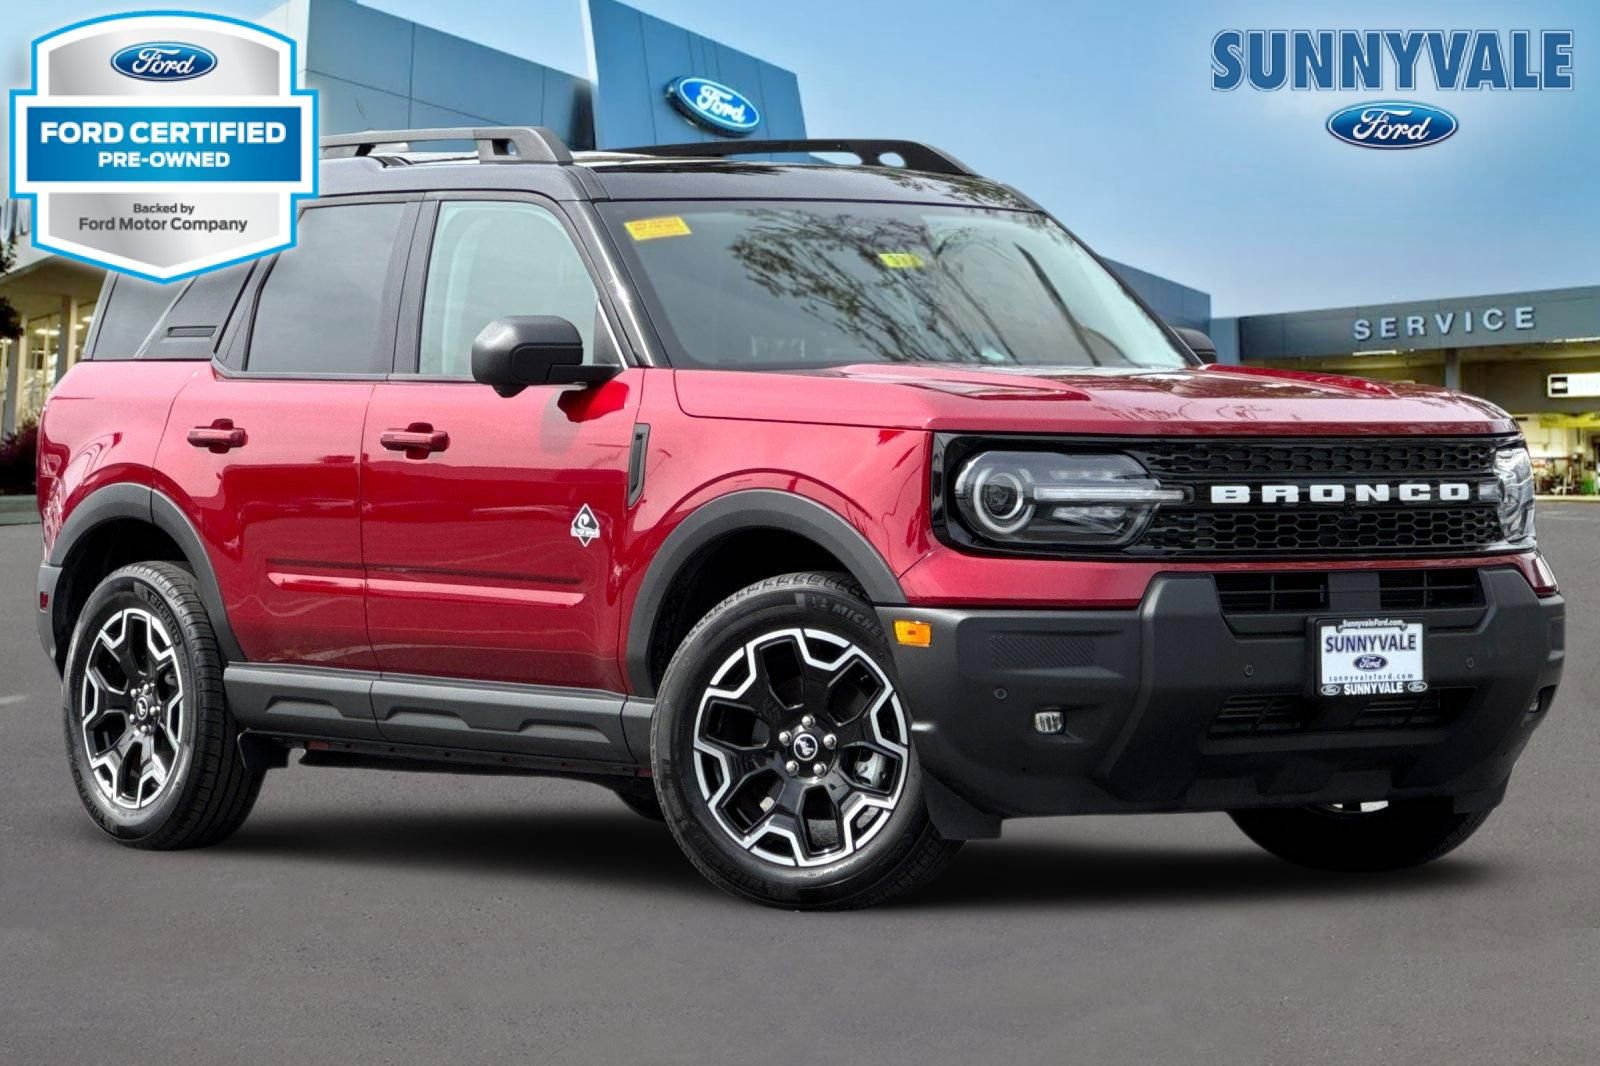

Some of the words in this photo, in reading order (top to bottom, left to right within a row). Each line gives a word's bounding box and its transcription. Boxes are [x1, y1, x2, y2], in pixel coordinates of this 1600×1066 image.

[696, 85, 746, 122] Ford
[1352, 306, 1537, 341] SERVICE
[1210, 483, 1470, 504] BRONCO
[1342, 619, 1404, 629] SunnyvaleFord.com
[1325, 634, 1416, 653] SUNNYVALE
[1329, 672, 1414, 683] sunnyvaleford.com
[1343, 681, 1405, 696] SUNNYVALE
